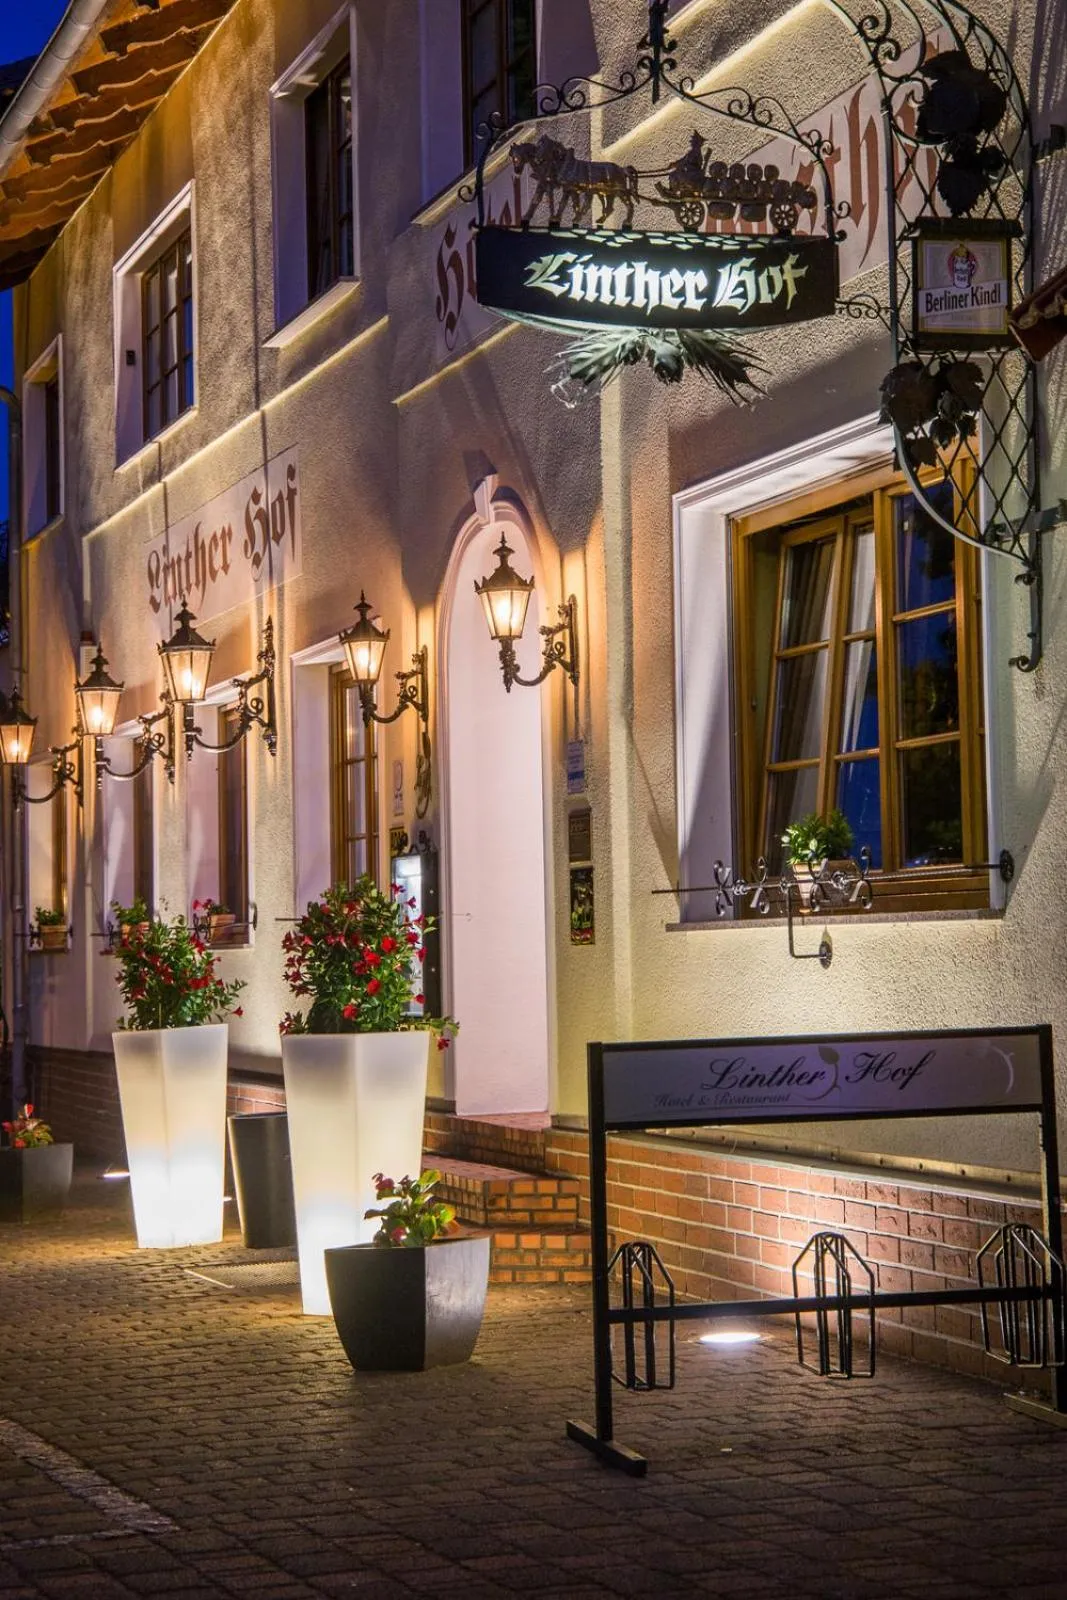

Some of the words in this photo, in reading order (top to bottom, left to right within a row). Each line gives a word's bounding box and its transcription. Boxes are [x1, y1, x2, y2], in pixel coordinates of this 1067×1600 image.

[523, 251, 708, 316] Linther
[711, 252, 809, 316] Hof
[925, 290, 969, 313] Berliner
[970, 283, 1001, 307] Kindl
[147, 521, 234, 614] Linther
[243, 463, 298, 583] Hof
[702, 1056, 826, 1091] Linther
[845, 1051, 937, 1091] Hof
